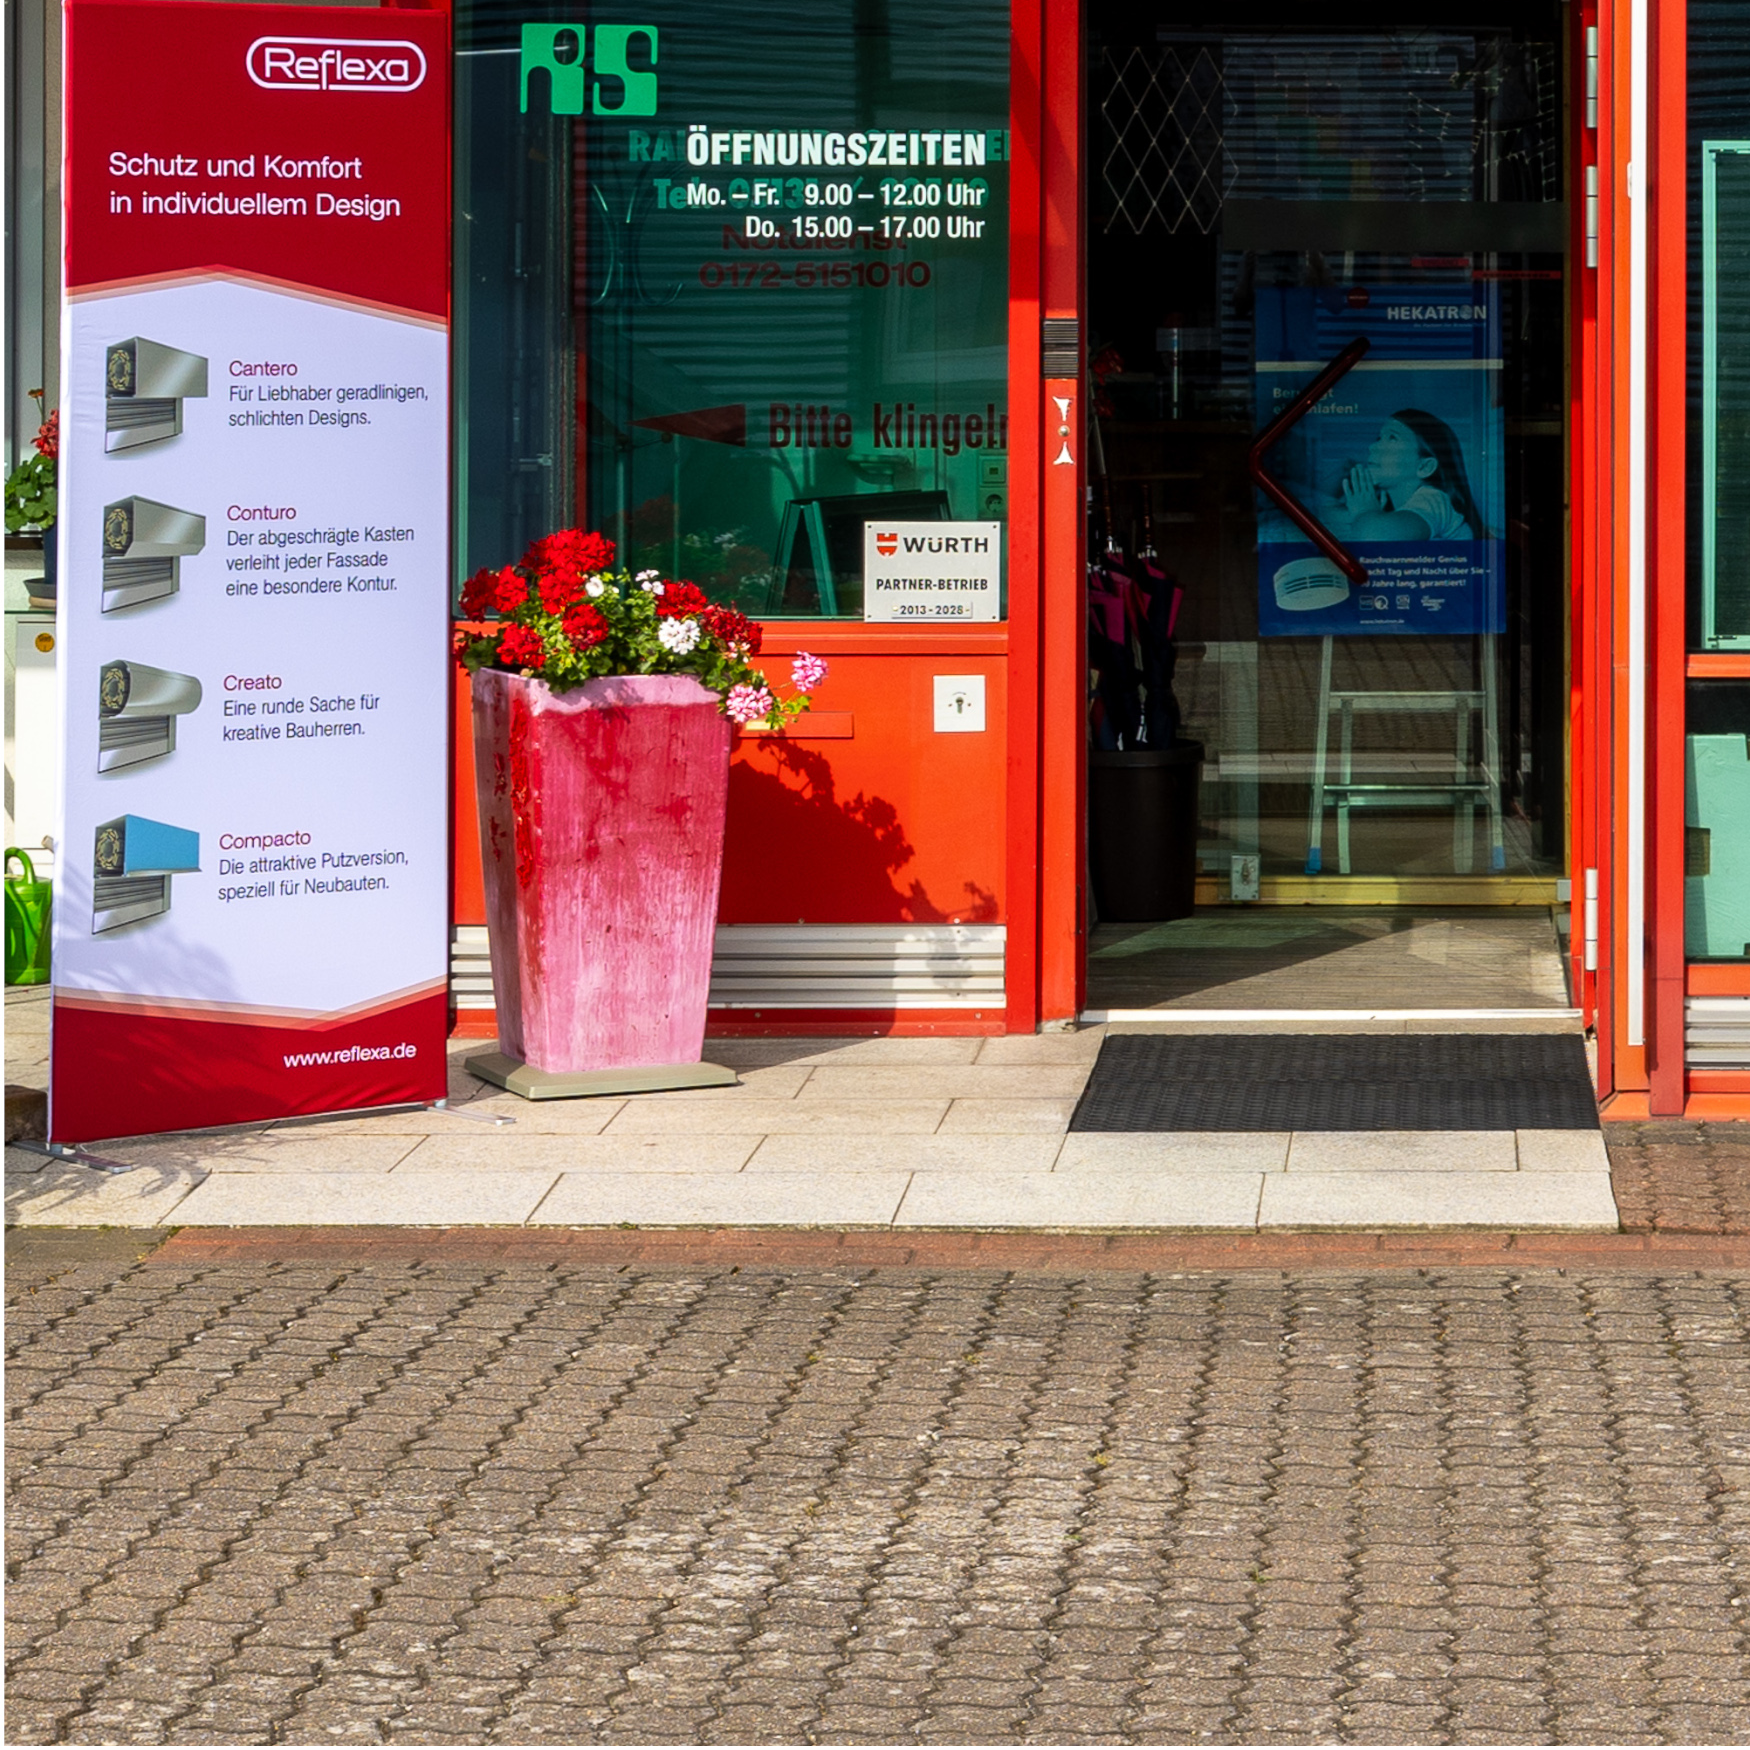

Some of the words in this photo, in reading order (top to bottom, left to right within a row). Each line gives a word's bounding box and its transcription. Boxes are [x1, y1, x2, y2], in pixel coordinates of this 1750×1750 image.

[265, 47, 409, 90] Reflexa
[687, 125, 986, 166] ÖFFNUNGSZEITEN
[109, 152, 198, 176] Schutz
[208, 155, 254, 177] und
[265, 155, 362, 178] Komfort
[687, 184, 726, 206] Mo.
[753, 184, 779, 206] Fr.
[804, 184, 852, 206] 9.00
[880, 184, 939, 206] 12.00
[947, 184, 985, 206] Uhr
[111, 191, 131, 213] in
[143, 191, 306, 215] individuellem
[317, 194, 400, 220] Design
[745, 217, 780, 238] Do.
[792, 217, 852, 238] 15.00
[880, 217, 939, 238] 17.00
[947, 217, 985, 238] Uhr
[699, 261, 930, 288] 0172-5151010
[1387, 305, 1487, 320] HEKATRON
[229, 361, 297, 376] Cantero
[230, 386, 253, 401] Für
[259, 385, 332, 401] Liebhaber
[337, 384, 428, 403] geradlinigen,
[229, 411, 303, 426] schlichten
[309, 410, 370, 427] Designs.
[769, 404, 852, 449] Bitte
[227, 505, 296, 520] Conturo
[228, 531, 254, 546] Der
[259, 528, 359, 547] abgeschrägte
[365, 527, 414, 541] Kasten
[903, 537, 989, 553] WÜRTH
[226, 555, 279, 570] verleiht
[284, 554, 322, 572] jeder
[327, 551, 388, 567] Fassade
[1367, 568, 1386, 576] acht
[1388, 568, 1402, 577] Tag
[1404, 567, 1421, 576] und
[1422, 567, 1447, 576] Nacht
[226, 580, 258, 596] eine
[264, 578, 342, 594] besondere
[348, 576, 397, 591] Kontur.
[876, 579, 988, 591] PARTNER-BETRIEB
[1372, 579, 1395, 588] Jahre
[224, 675, 282, 691] Creato
[224, 700, 256, 716] Eine
[262, 698, 304, 714] runde
[310, 696, 355, 712] Sache
[361, 694, 379, 709] für
[224, 725, 280, 741] kreative
[287, 722, 365, 738] Bauherren.
[220, 831, 311, 851] Compacto
[220, 859, 244, 875] Die
[250, 856, 316, 873] attraktive
[322, 852, 408, 868] Putzversion,
[219, 881, 274, 902] speziell
[280, 880, 299, 895] für
[305, 876, 389, 894] Neubauten.
[284, 1043, 416, 1067] www.reflexa.de
